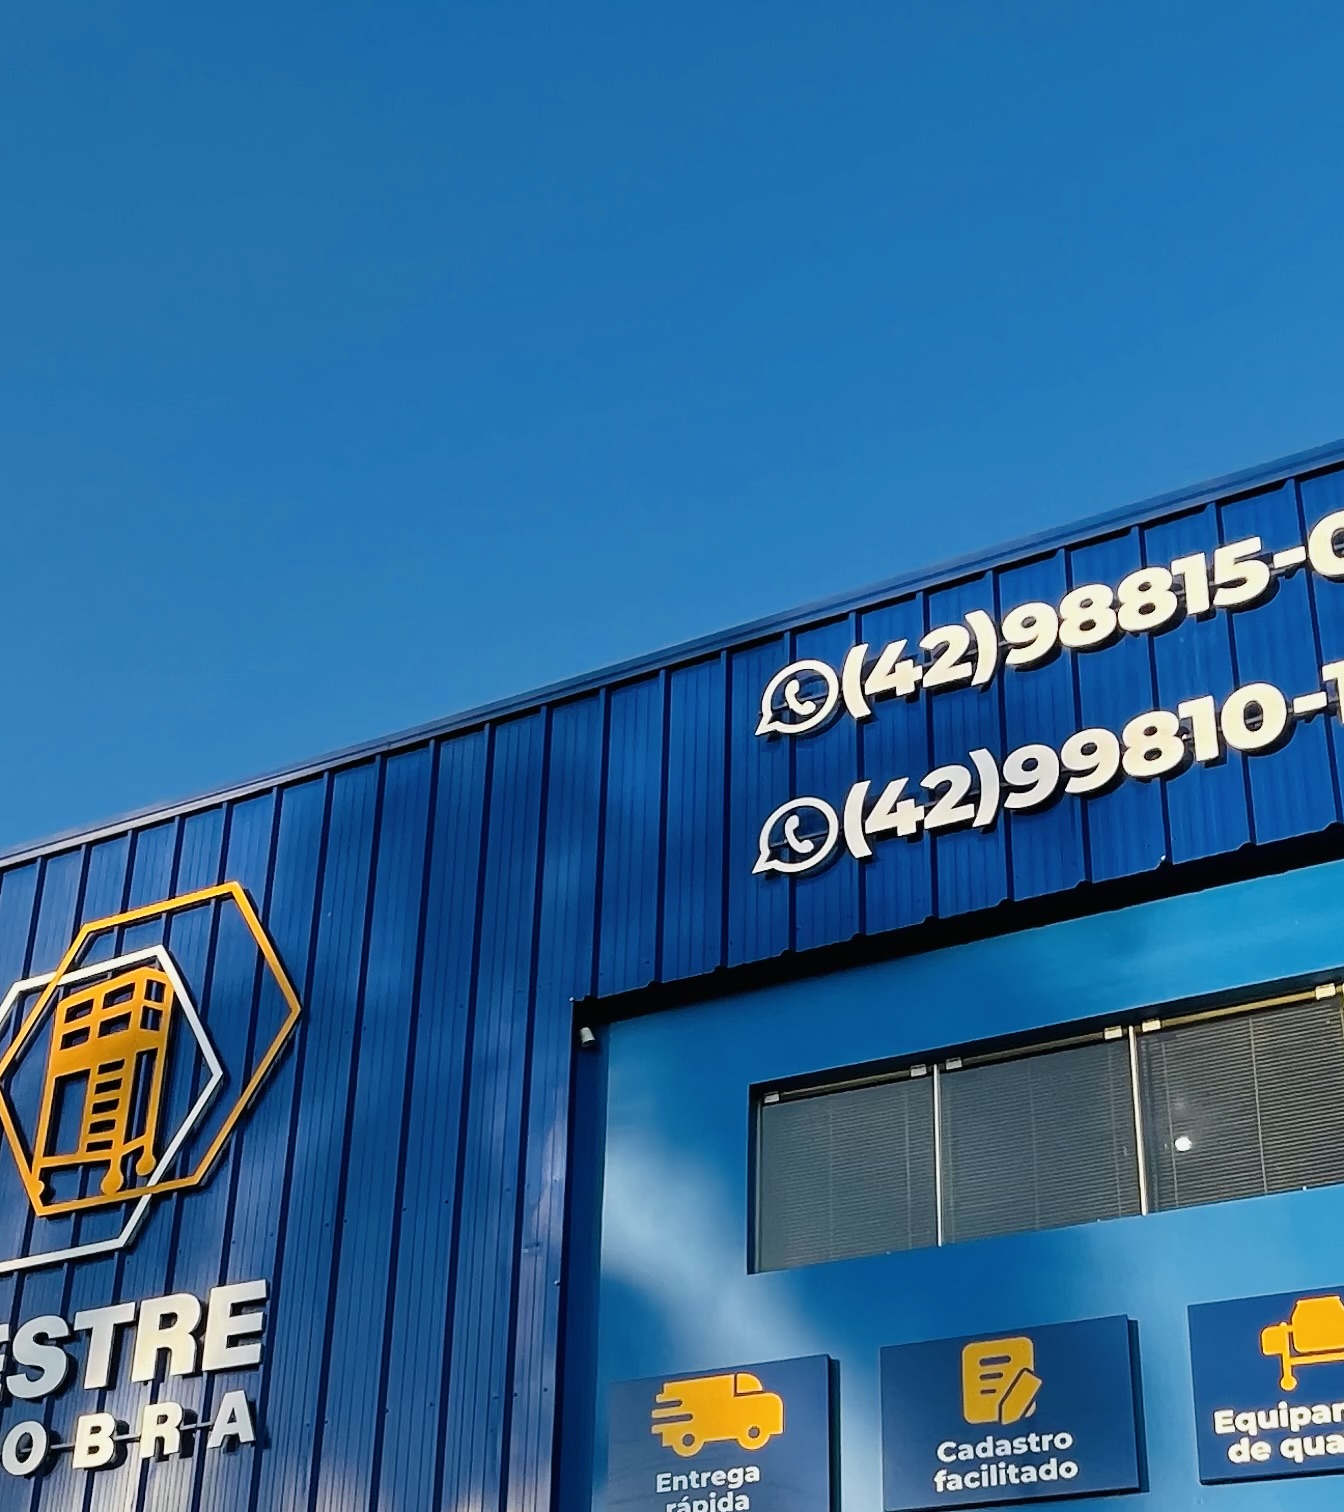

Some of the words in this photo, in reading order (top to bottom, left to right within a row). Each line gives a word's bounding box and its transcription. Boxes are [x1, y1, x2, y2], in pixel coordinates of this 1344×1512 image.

[1, 1389, 256, 1477] OBRA
[936, 1430, 1073, 1463] Cadastro
[1227, 1432, 1272, 1464] de
[656, 1464, 761, 1496] Entrega
[933, 1458, 1079, 1493] facilitado
